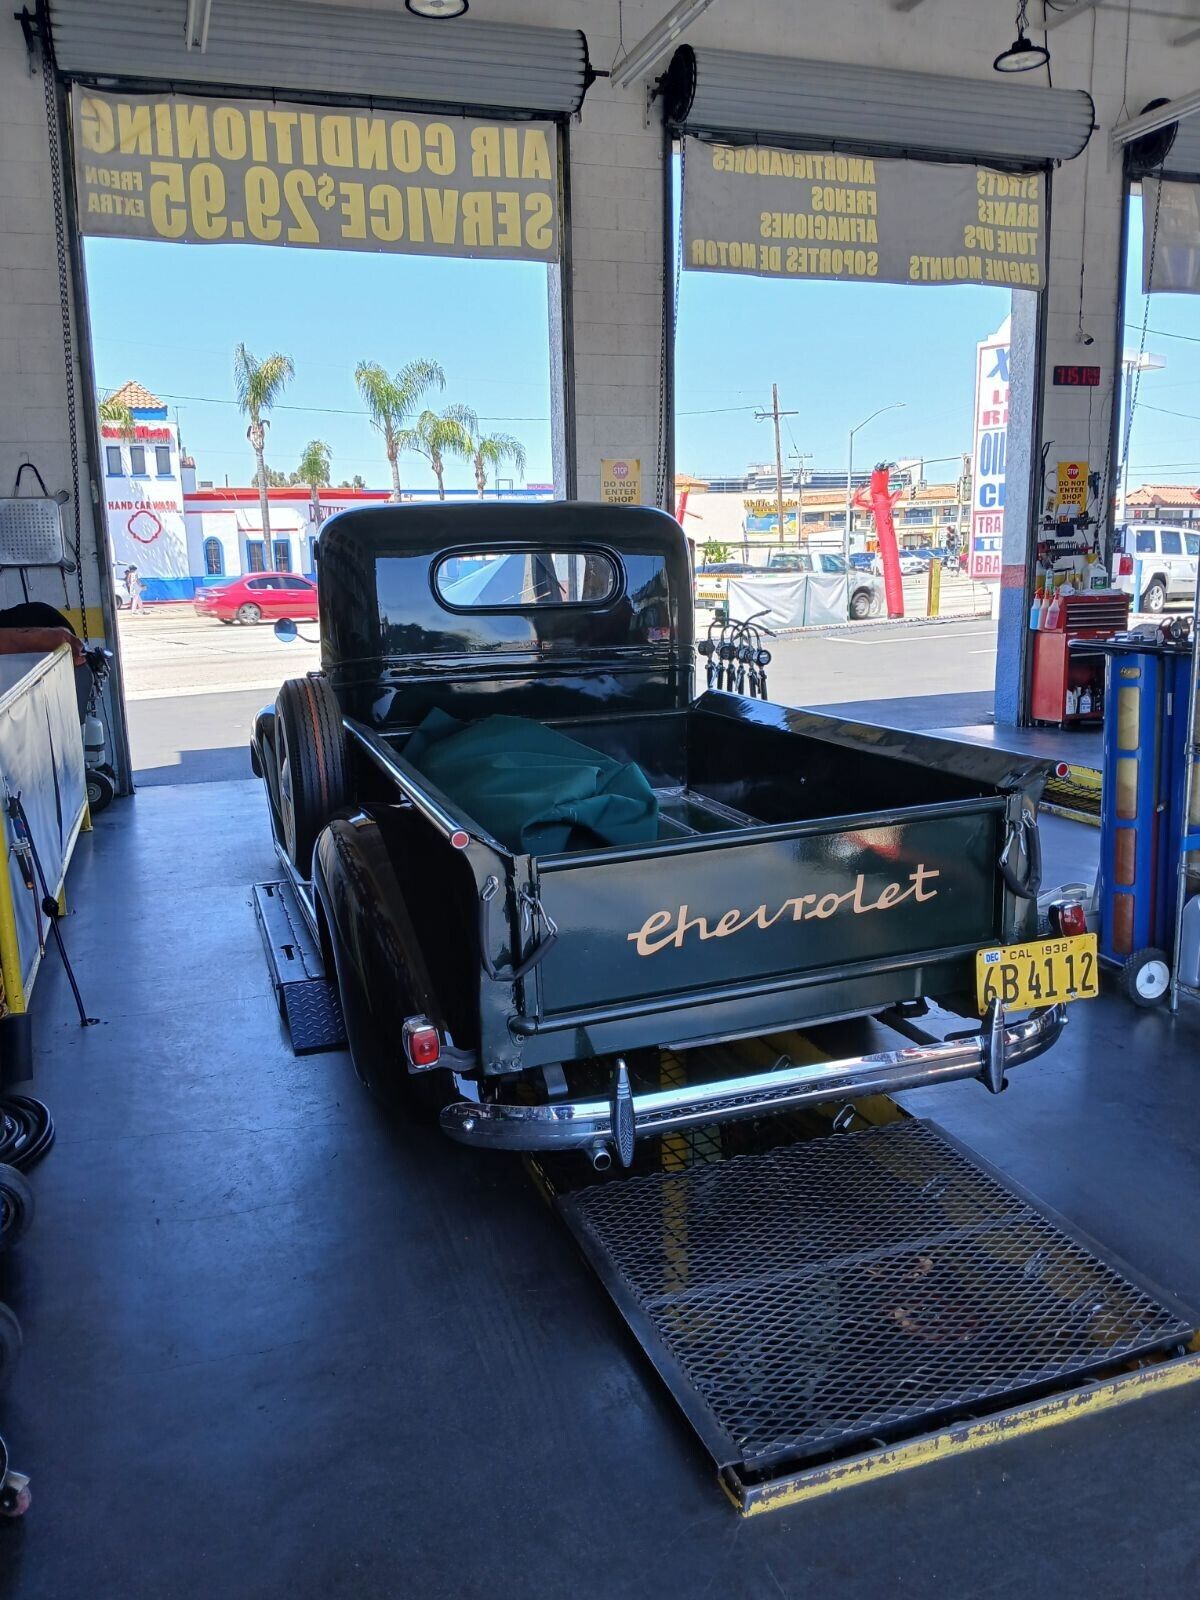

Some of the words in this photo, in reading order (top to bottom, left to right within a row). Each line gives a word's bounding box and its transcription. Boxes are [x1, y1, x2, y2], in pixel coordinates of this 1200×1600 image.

[980, 431, 1006, 476] OIL
[613, 466, 629, 474] STOP
[604, 480, 617, 488] DO
[619, 480, 638, 488] NOT
[605, 488, 636, 496] ENTER
[108, 501, 133, 510] HAND
[135, 501, 152, 510] CAR
[153, 501, 177, 510] WASH
[626, 863, 940, 957] Chevrolet
[1009, 949, 1032, 960] CAL
[1041, 943, 1068, 955] 1938
[985, 952, 999, 963] DEC
